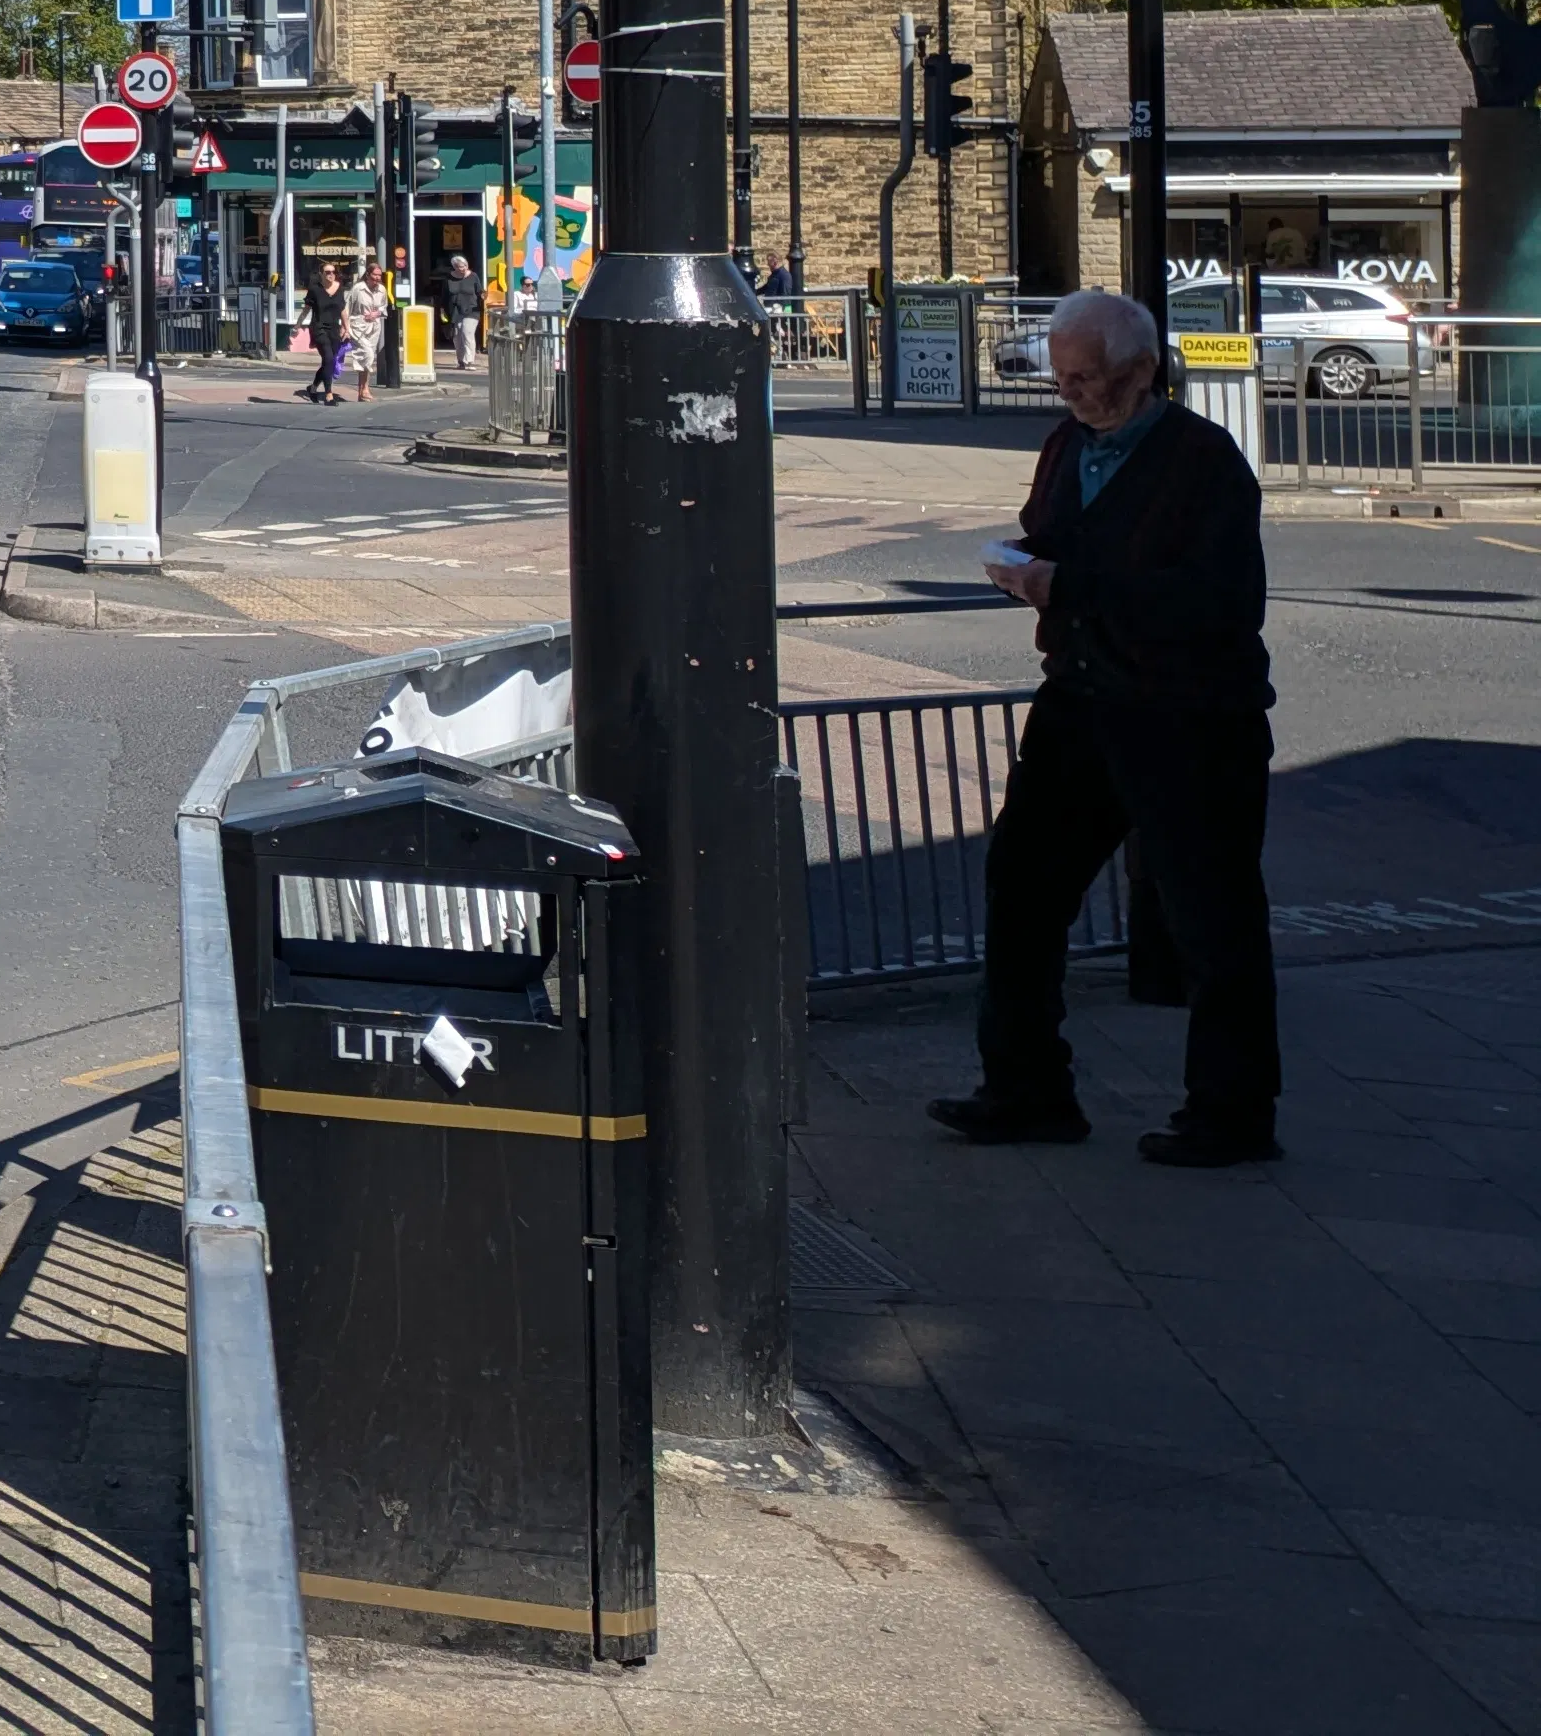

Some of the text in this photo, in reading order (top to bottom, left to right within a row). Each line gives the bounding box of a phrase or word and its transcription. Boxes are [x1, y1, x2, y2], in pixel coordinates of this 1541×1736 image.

[128, 68, 169, 93] 20
[1129, 125, 1153, 138] 585
[142, 152, 157, 165] S6
[253, 158, 277, 170] TH
[289, 157, 351, 171] CHEESY
[1166, 258, 1224, 282] VA
[1337, 259, 1438, 284] KOVA
[1183, 339, 1248, 353] DANGER
[910, 366, 951, 380] LOOK
[907, 381, 955, 396] RIGHT!
[336, 1025, 495, 1072] LITTR
